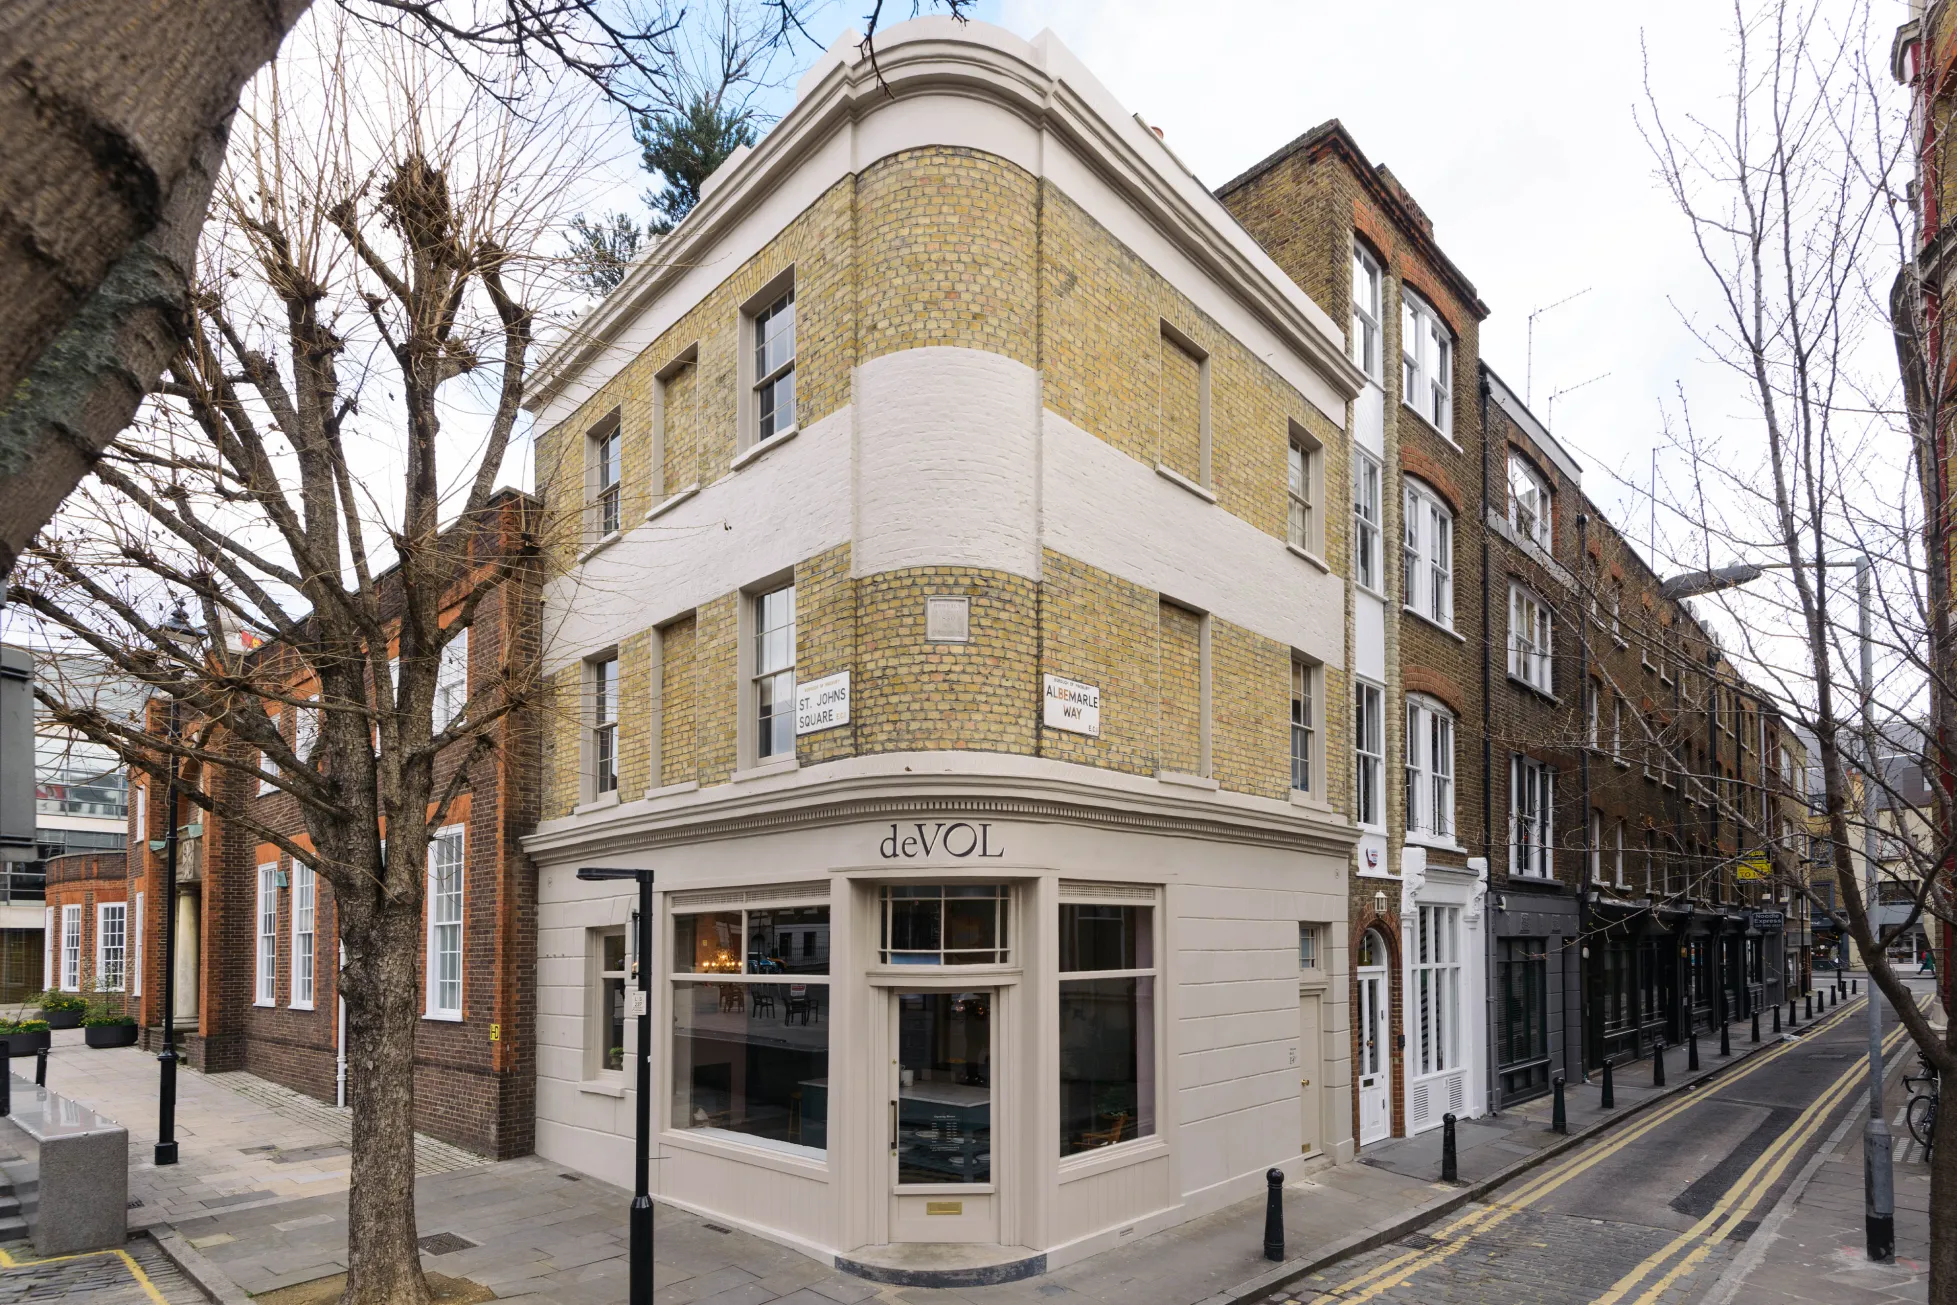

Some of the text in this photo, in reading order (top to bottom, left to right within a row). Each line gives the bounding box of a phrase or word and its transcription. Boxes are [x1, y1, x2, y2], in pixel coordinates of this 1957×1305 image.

[799, 687, 846, 711] ST. JOHNS
[1046, 684, 1098, 709] ALBEMARLE
[799, 709, 833, 729] SQUARE
[1063, 704, 1082, 720] WAY
[880, 822, 1005, 859] deVOL
